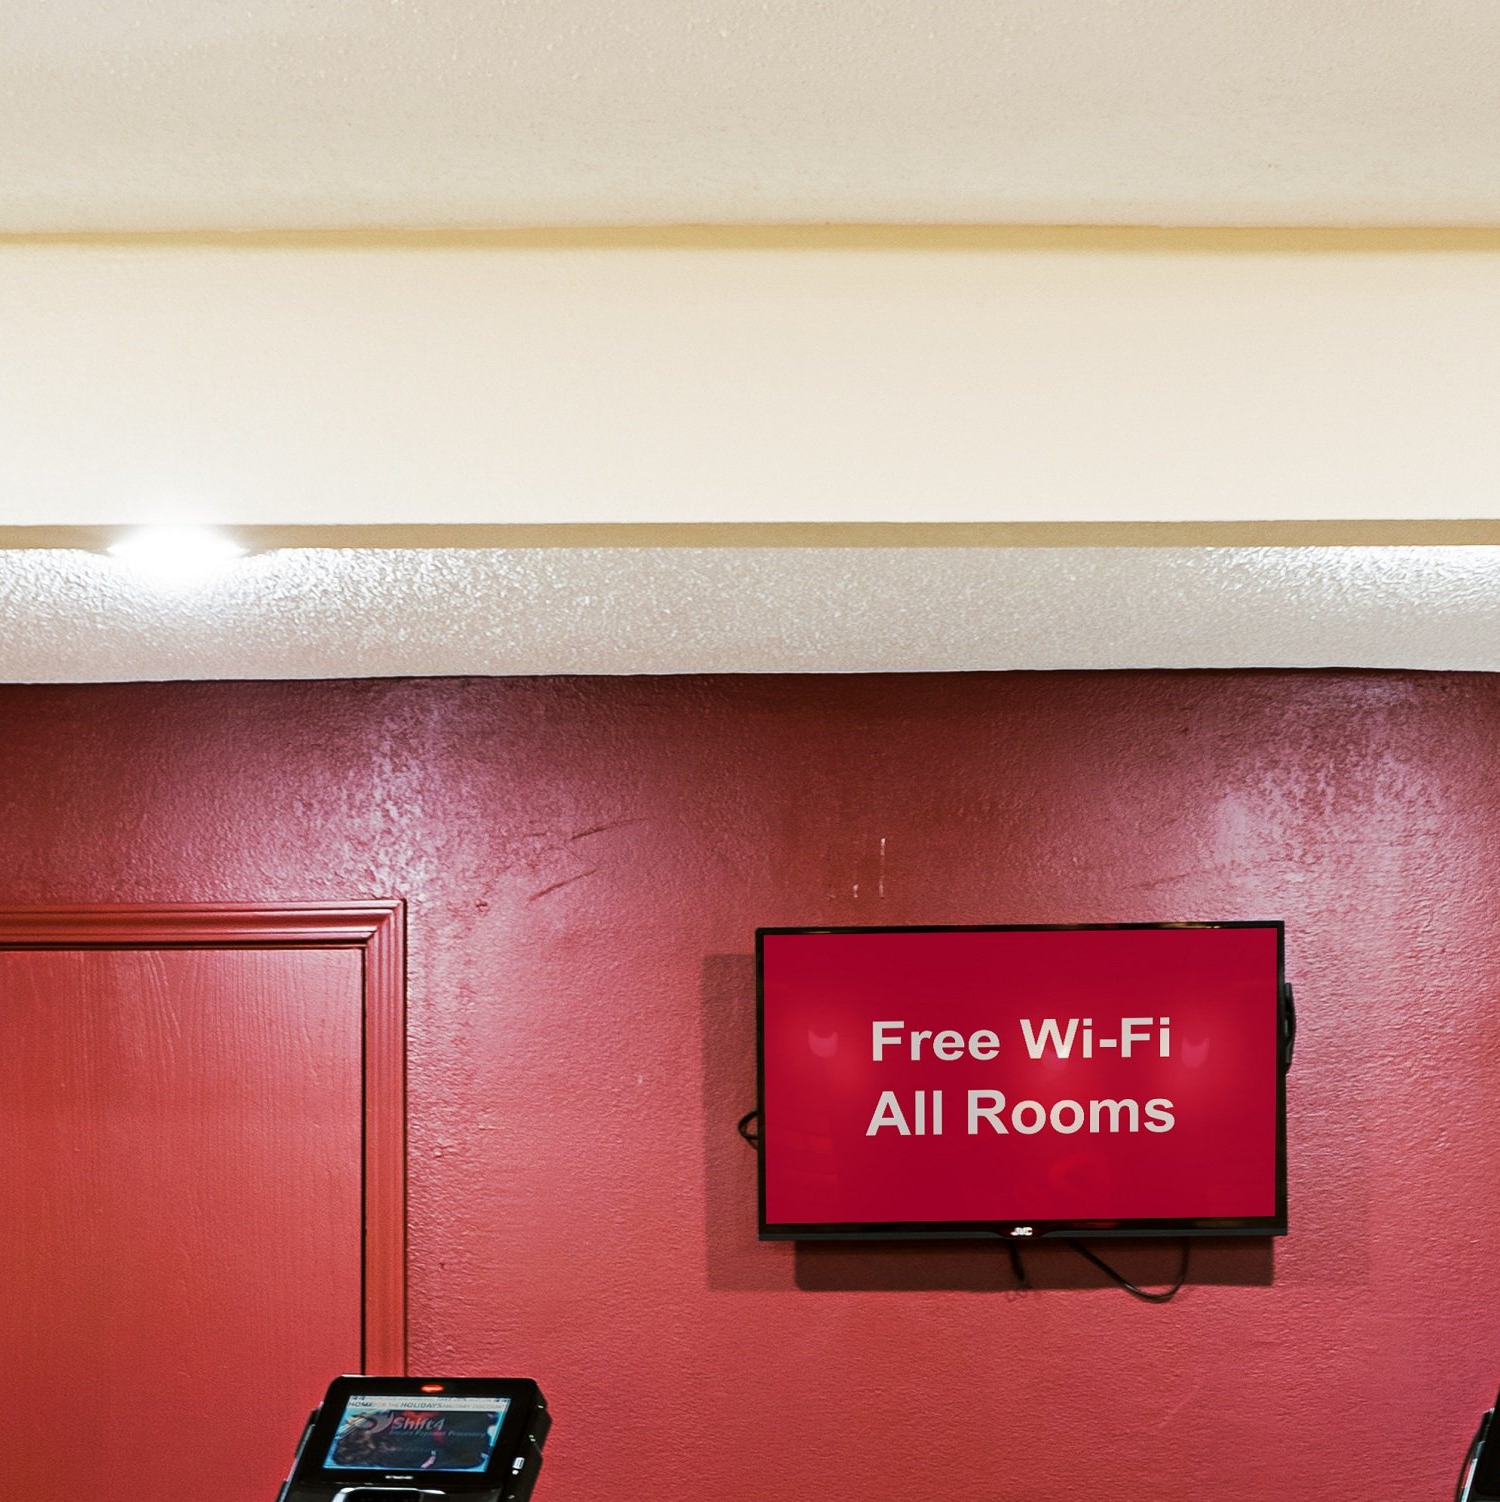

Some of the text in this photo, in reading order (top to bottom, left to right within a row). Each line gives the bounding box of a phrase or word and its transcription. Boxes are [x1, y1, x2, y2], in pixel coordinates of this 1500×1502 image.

[872, 1016, 1172, 1062] Free Wi-Fi
[866, 1089, 1176, 1137] All Rooms
